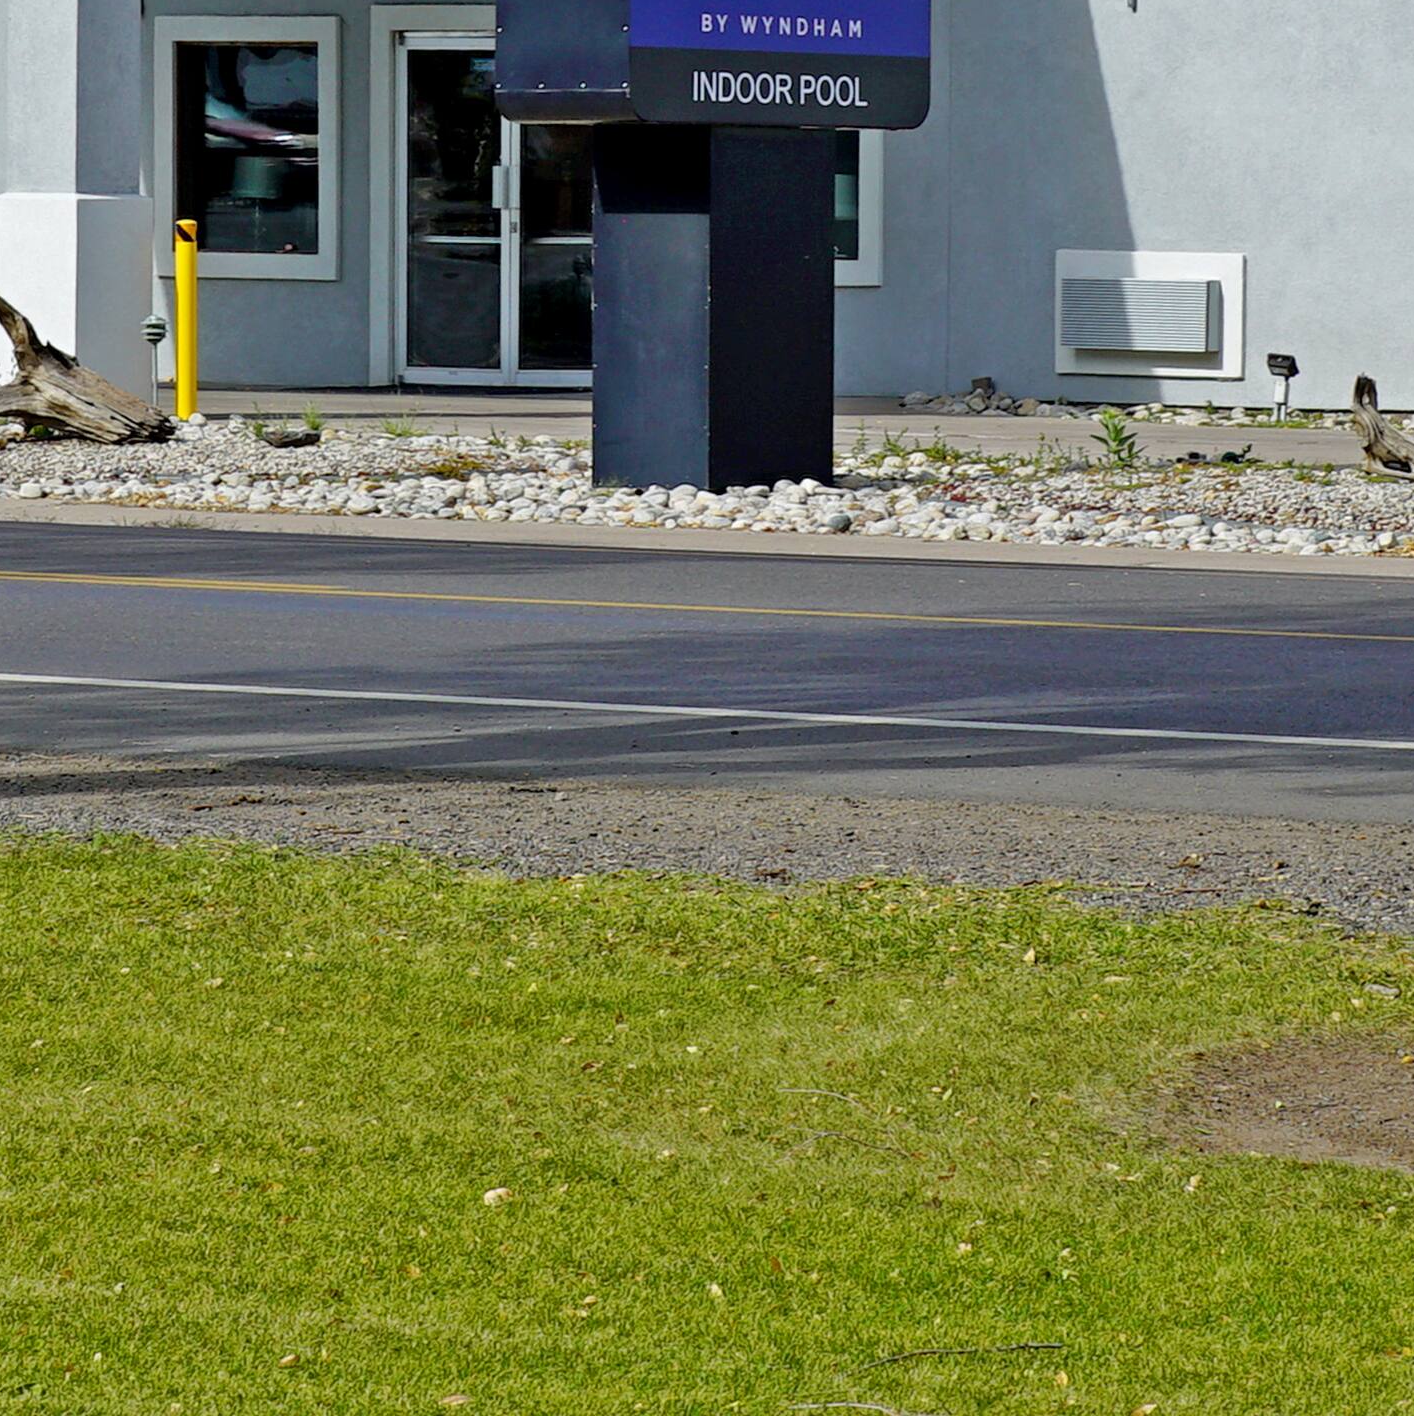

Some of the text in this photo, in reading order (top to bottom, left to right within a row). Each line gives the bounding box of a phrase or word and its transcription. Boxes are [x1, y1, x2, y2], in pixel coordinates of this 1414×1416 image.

[701, 13, 862, 38] BY WYNDHAM
[693, 71, 868, 107] INDOOR POOL
